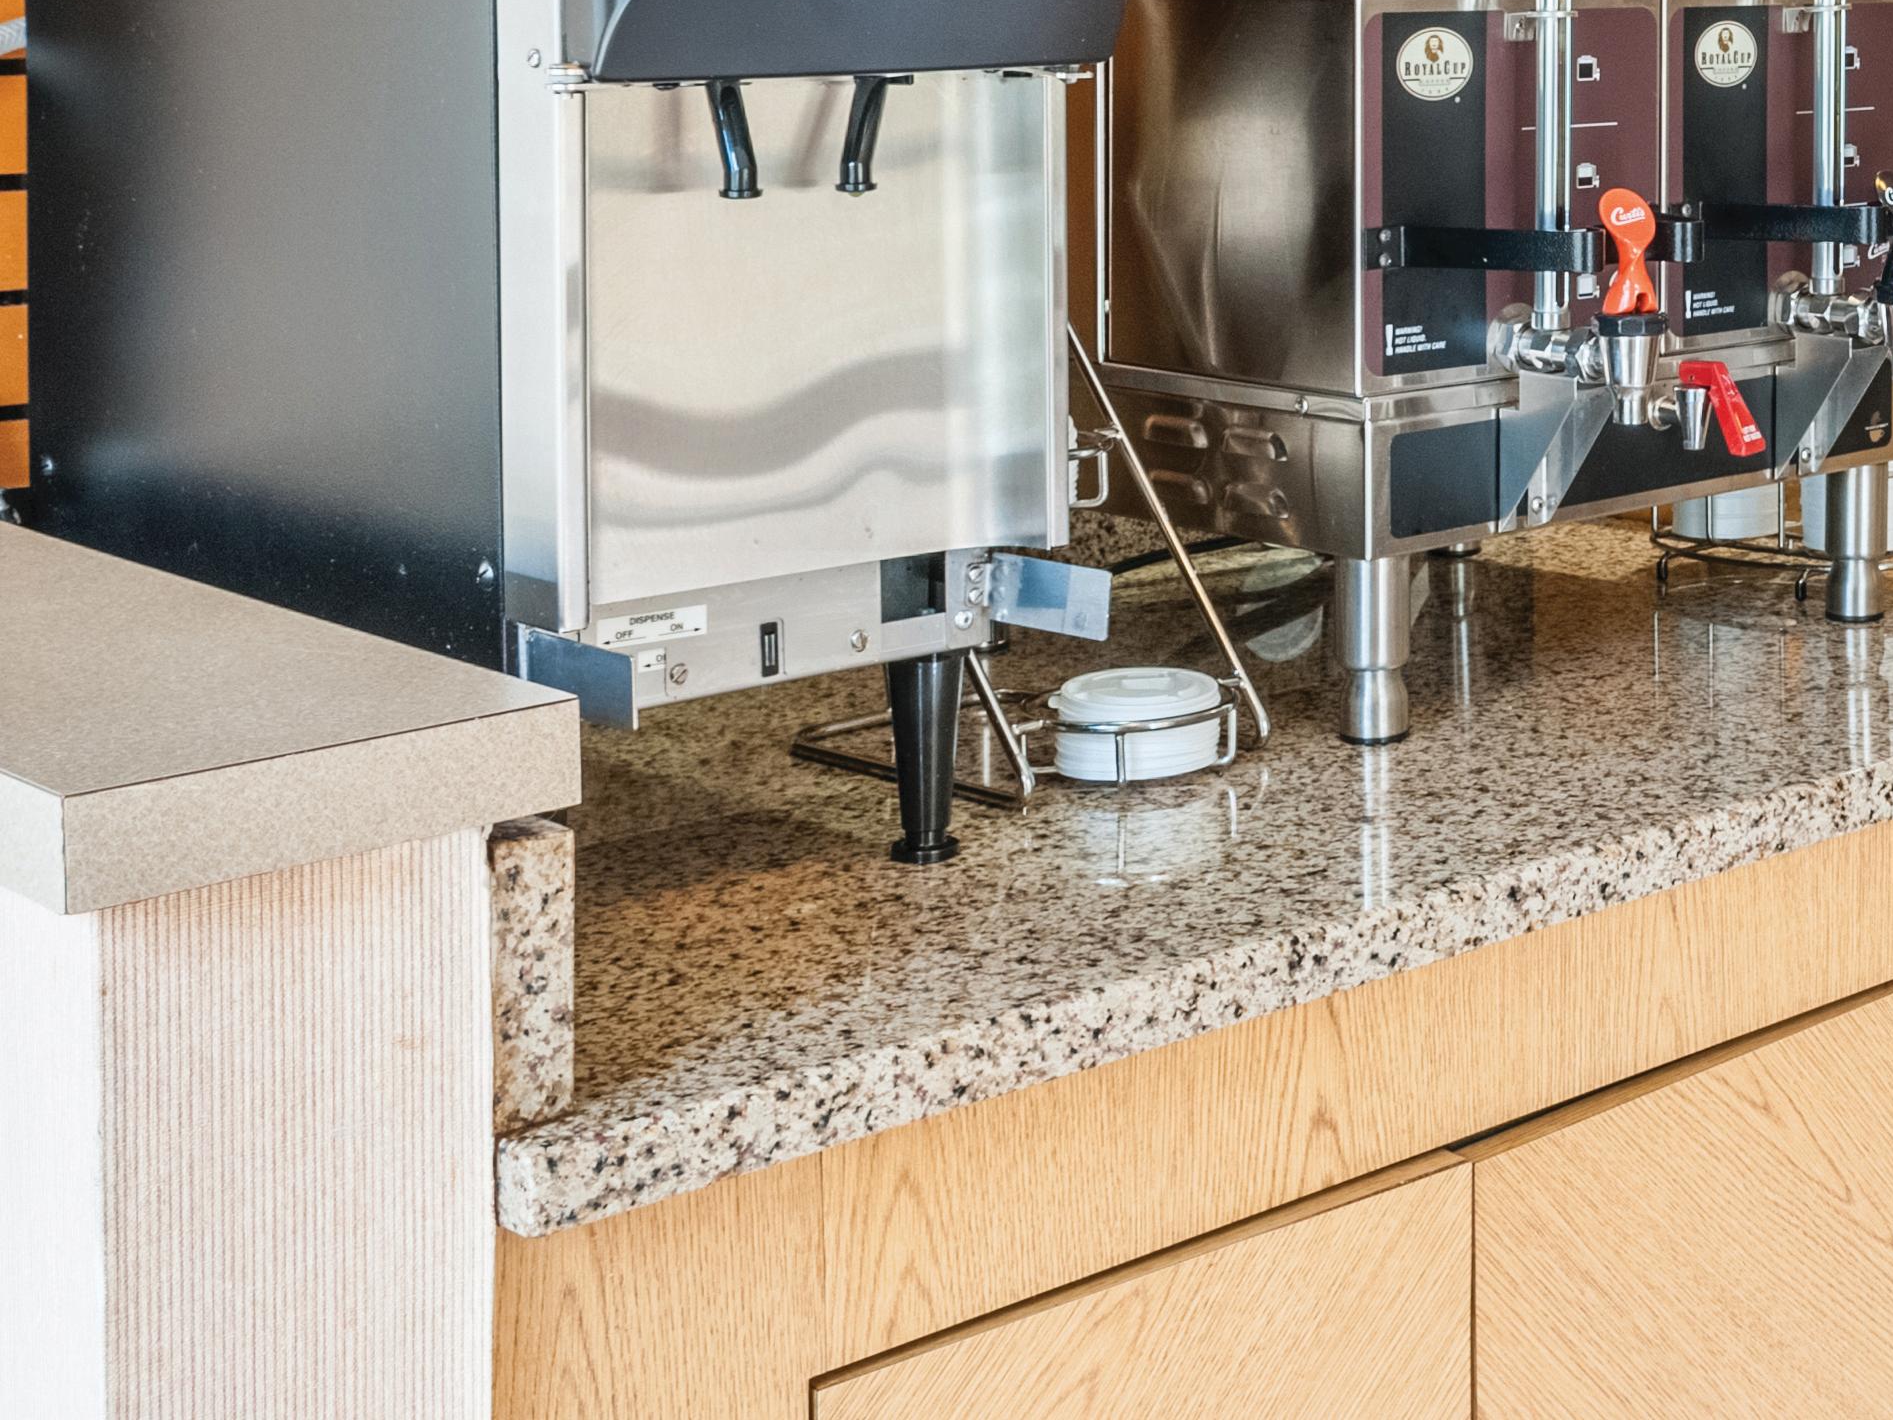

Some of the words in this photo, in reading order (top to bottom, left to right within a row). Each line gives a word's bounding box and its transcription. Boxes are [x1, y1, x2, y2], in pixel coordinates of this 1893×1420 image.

[629, 611, 675, 626] DISPENSE
[615, 629, 633, 640] OFF
[670, 623, 684, 632] ON
